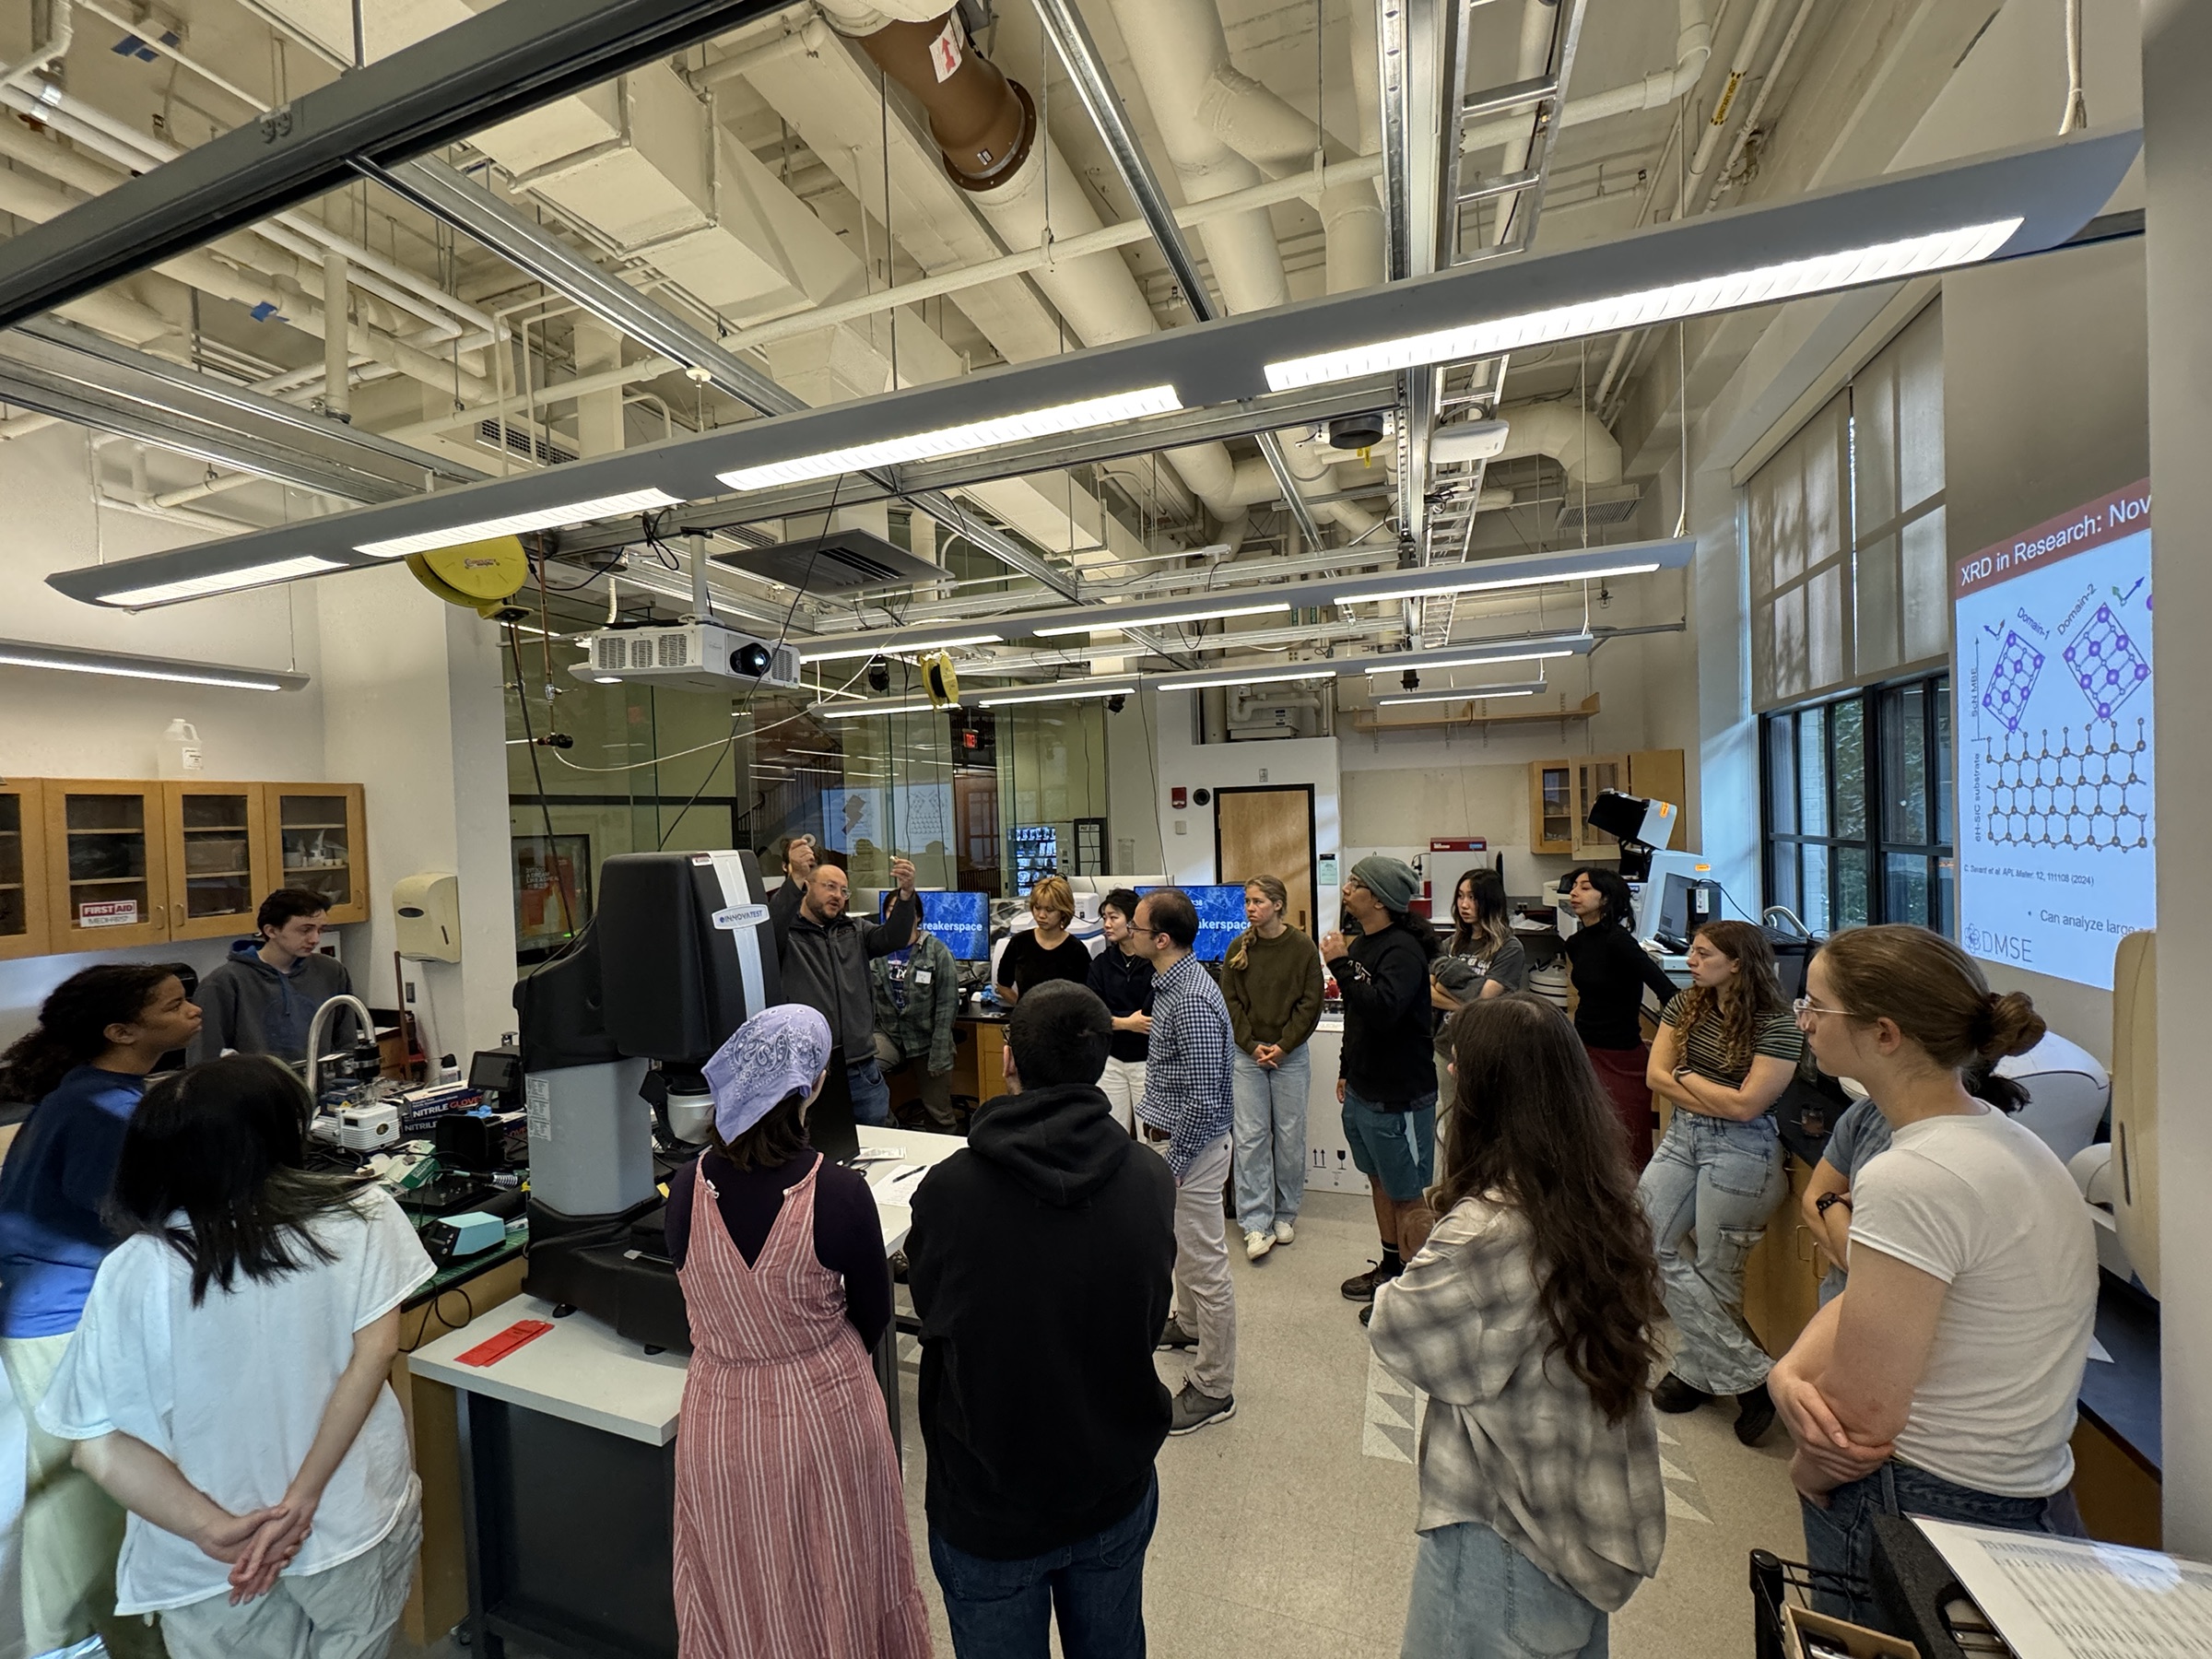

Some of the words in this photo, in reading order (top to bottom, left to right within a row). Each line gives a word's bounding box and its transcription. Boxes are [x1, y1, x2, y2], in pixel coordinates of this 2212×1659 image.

[1960, 557, 1993, 586] XRD
[1996, 552, 2010, 571] in
[2014, 514, 2103, 565] Research:
[2056, 582, 2097, 636] Domain-2
[2017, 606, 2051, 641] Domain-1
[1971, 667, 1979, 696] MBE
[2071, 874, 2095, 887] (2024)
[84, 905, 114, 914] FIRST
[724, 910, 763, 922] INNOVATEST
[2040, 909, 2060, 924] Can
[2063, 914, 2103, 933] analyze
[1982, 930, 2033, 963] DMSE
[412, 1102, 450, 1118] NITRILE
